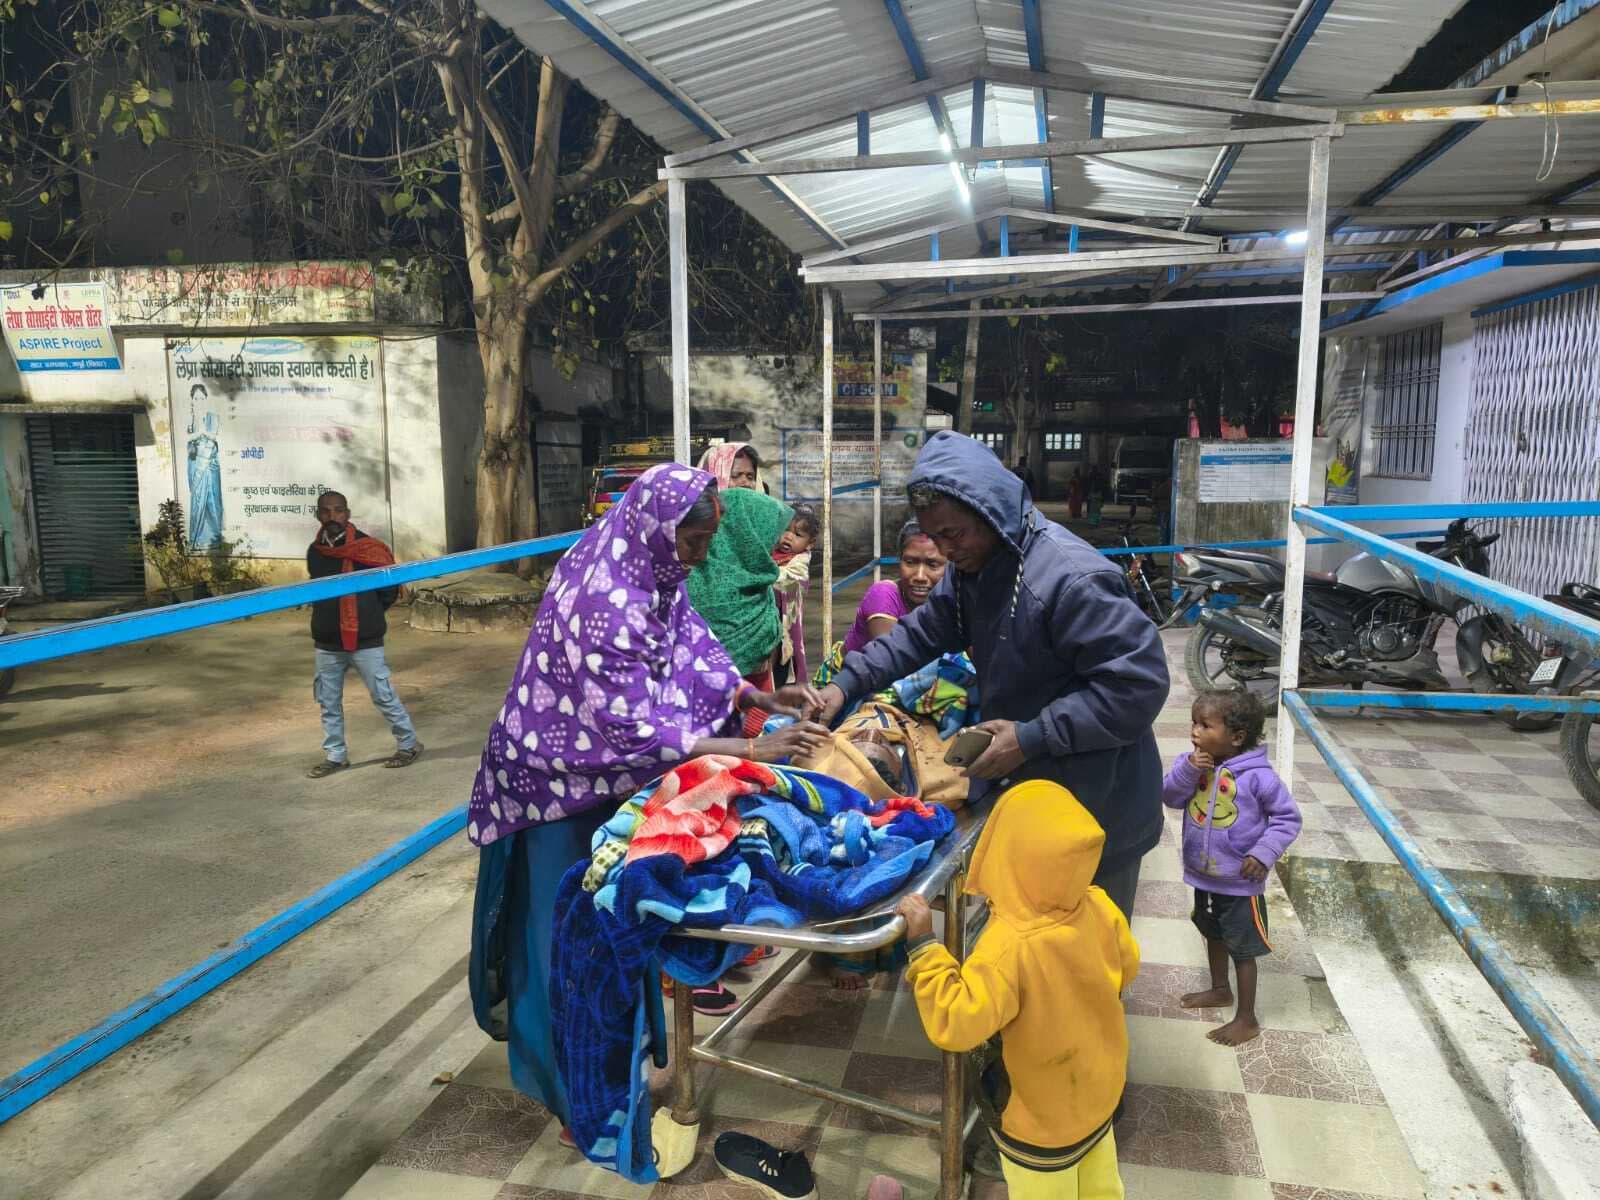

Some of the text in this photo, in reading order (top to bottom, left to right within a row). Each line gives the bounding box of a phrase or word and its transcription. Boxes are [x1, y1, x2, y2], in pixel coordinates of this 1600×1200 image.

[5, 306, 23, 329] लेप्रा
[19, 337, 103, 351] ASPIRE Project
[176, 355, 197, 381] लेप्रा
[200, 353, 245, 381] सोसाईटी
[247, 361, 285, 378] आपका
[287, 361, 324, 379] स्वागत
[326, 354, 357, 378] करती
[842, 383, 856, 395] CT
[240, 446, 265, 460] ओपीडी
[242, 486, 258, 500] कुष्ठ
[260, 483, 270, 496] एवं
[308, 484, 316, 496] के
[280, 504, 302, 514] चप्पल
